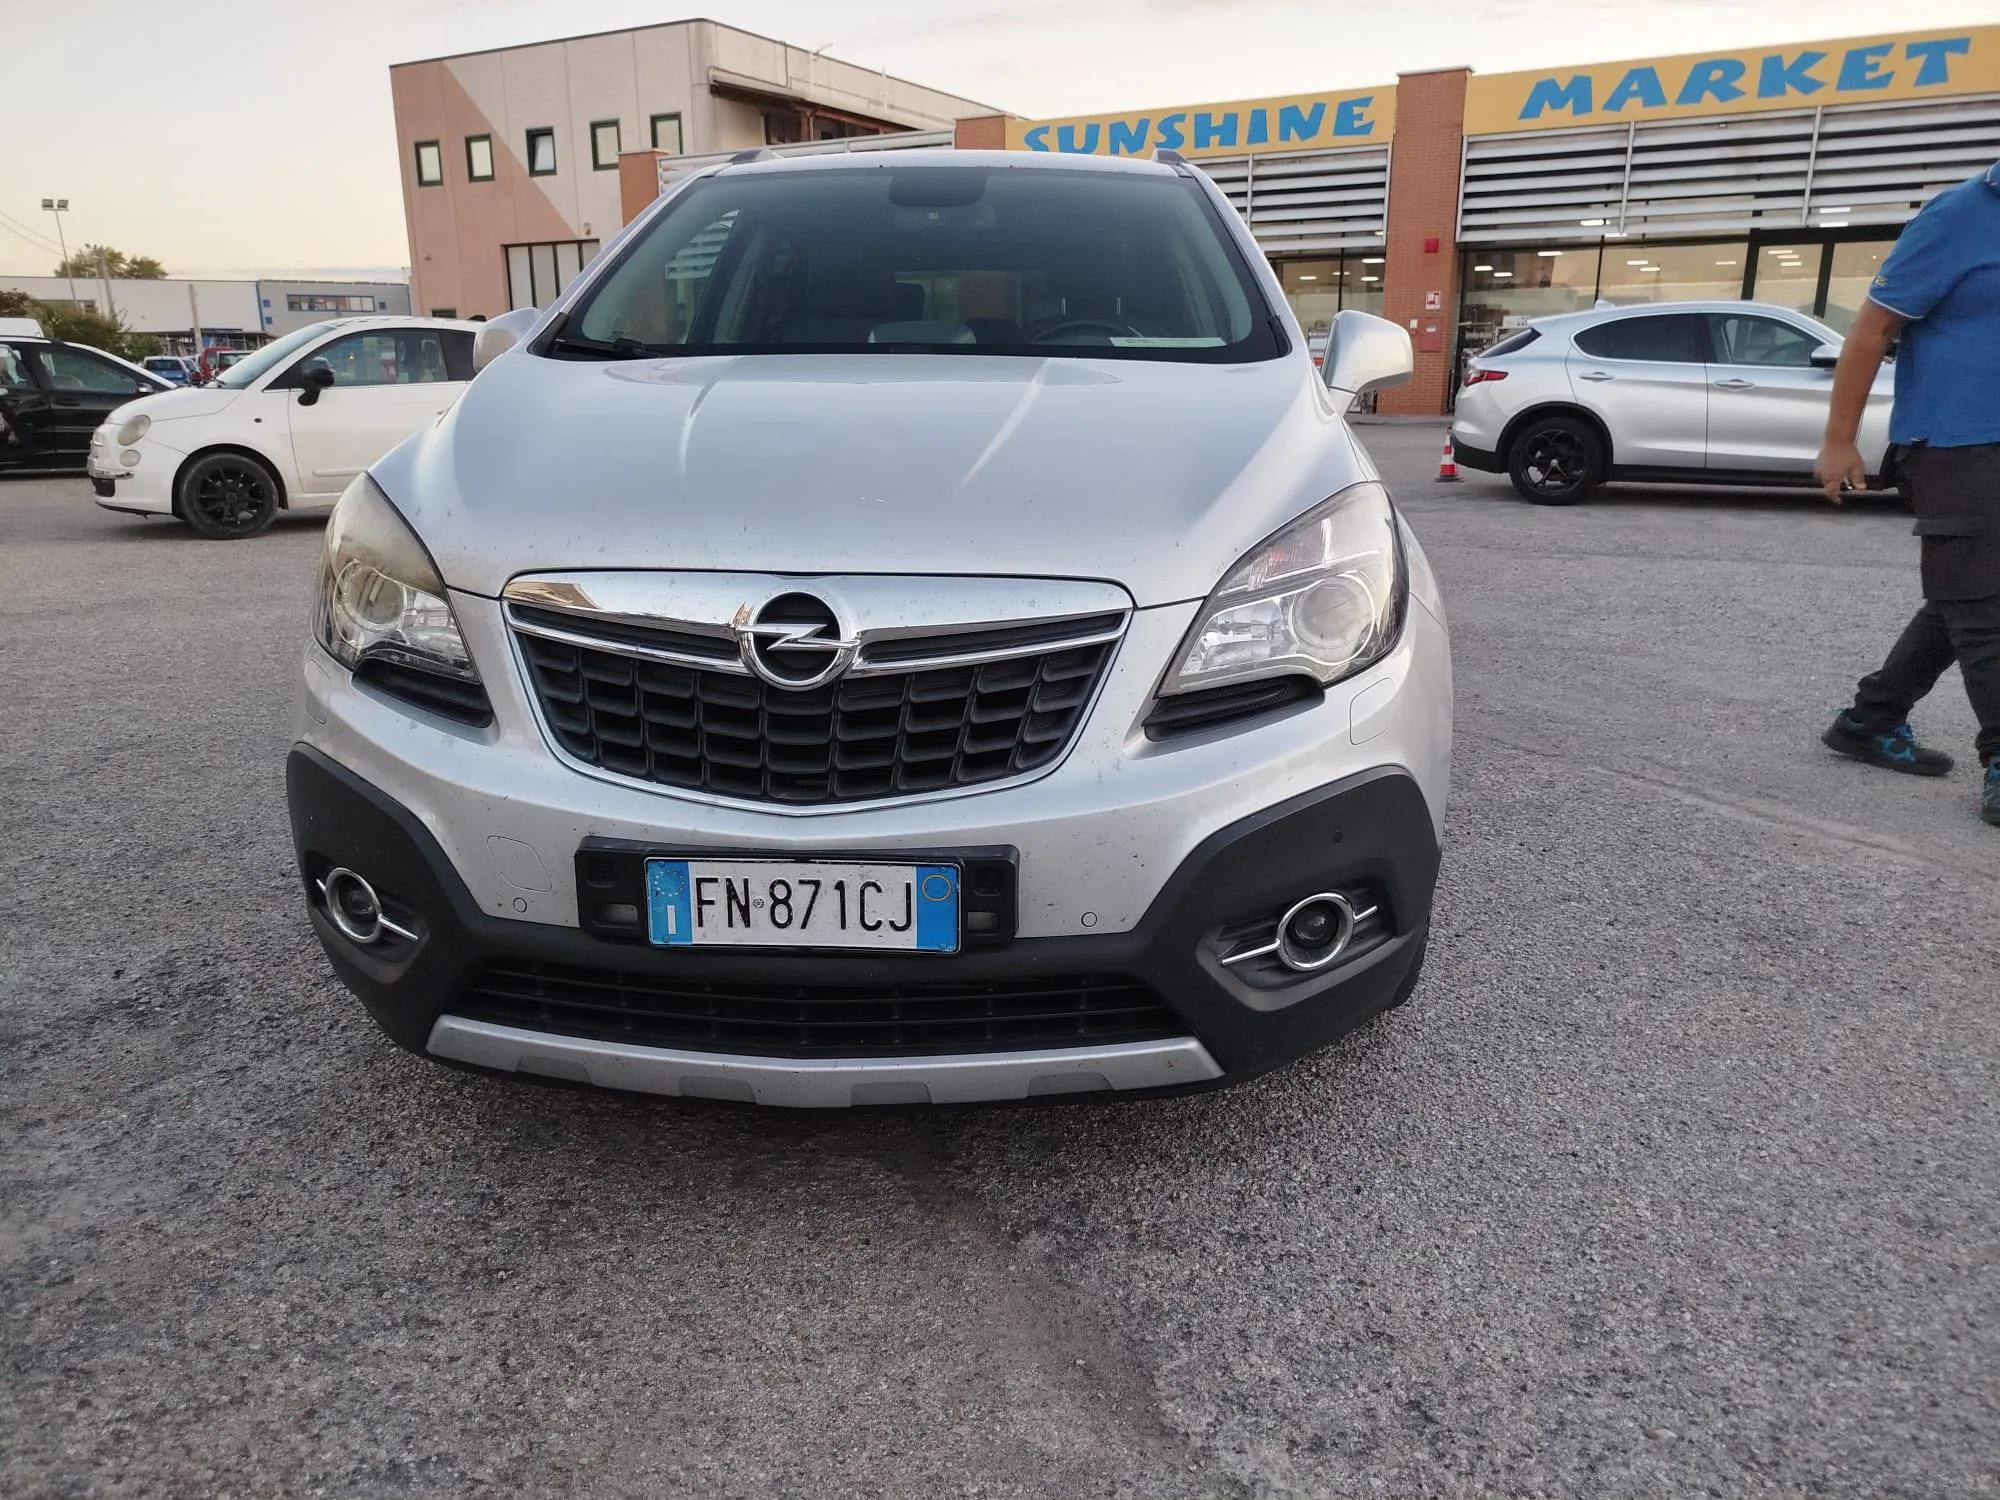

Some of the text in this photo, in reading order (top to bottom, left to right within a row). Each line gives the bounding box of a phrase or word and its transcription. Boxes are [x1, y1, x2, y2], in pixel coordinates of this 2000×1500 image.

[1023, 36, 1971, 155] SUNSHINE MARKET
[666, 904, 677, 935] I
